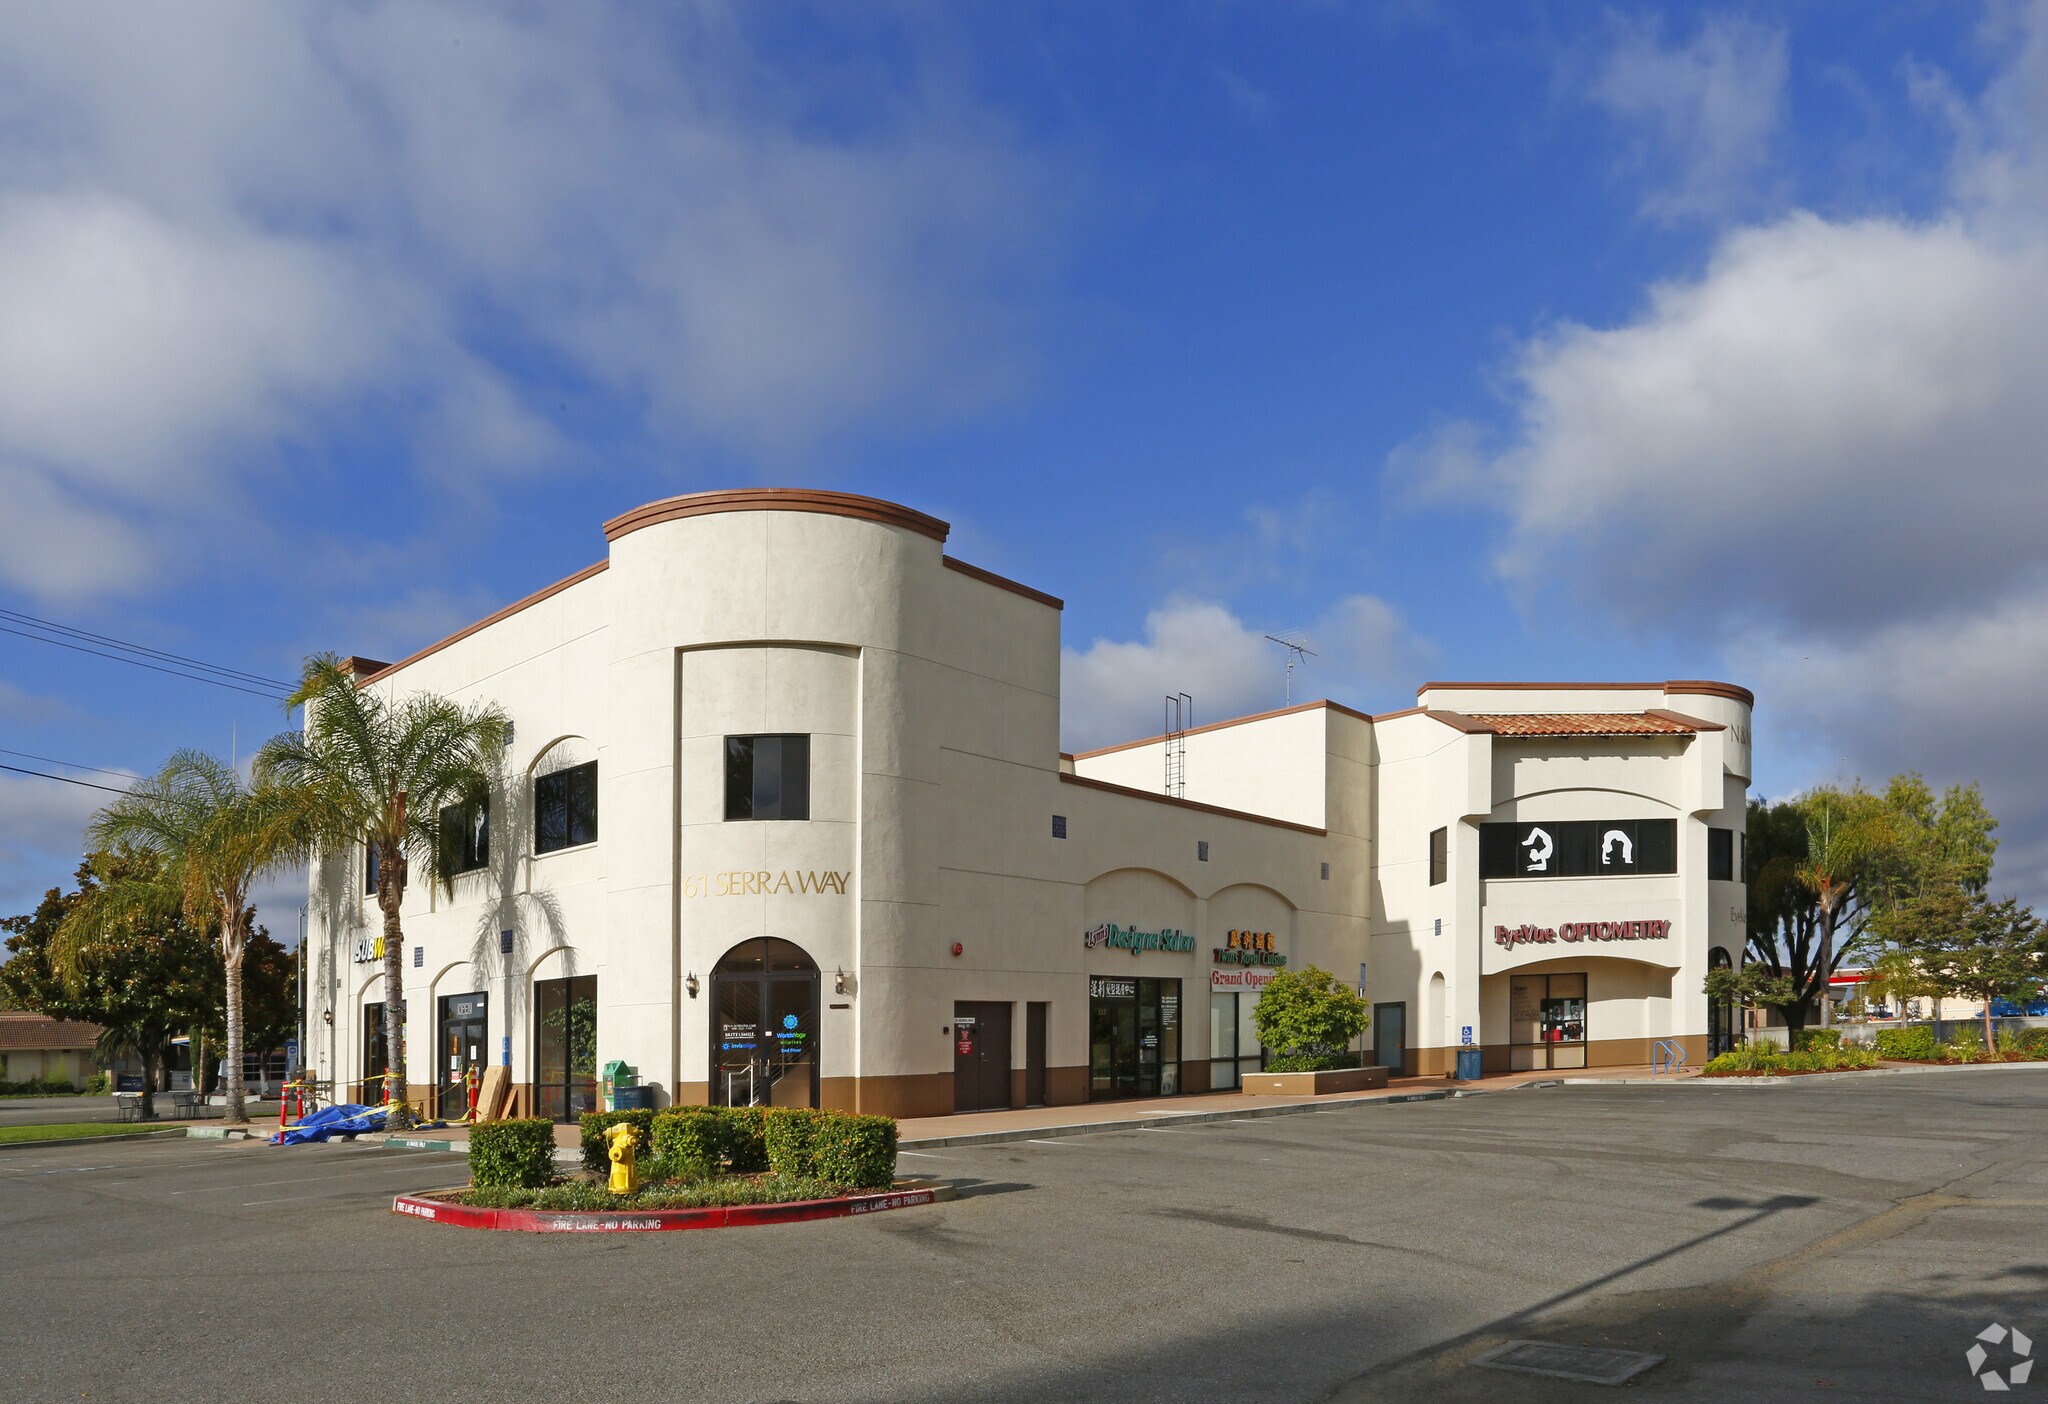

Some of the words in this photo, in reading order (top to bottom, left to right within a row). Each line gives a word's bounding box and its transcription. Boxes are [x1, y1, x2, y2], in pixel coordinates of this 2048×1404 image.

[684, 873, 708, 898] 61
[715, 870, 795, 897] SERRA
[796, 870, 852, 895] WAY
[1086, 924, 1109, 948] Lynn's
[1108, 924, 1162, 955] Designer
[1163, 928, 1195, 952] Salon
[1494, 924, 1557, 950] EyeVue
[1559, 919, 1672, 943] OPTOMETRY
[1216, 948, 1239, 964] Twins
[1241, 950, 1260, 967] Royal
[1263, 951, 1287, 966] Cuisine
[1212, 970, 1242, 985] Grand
[396, 1201, 405, 1212] FIRE
[420, 1206, 436, 1219] PARKING
[851, 1202, 868, 1213] FIRE
[903, 1193, 930, 1205] PARKING
[553, 1220, 572, 1230] FIRE
[621, 1219, 662, 1229] PARKING
